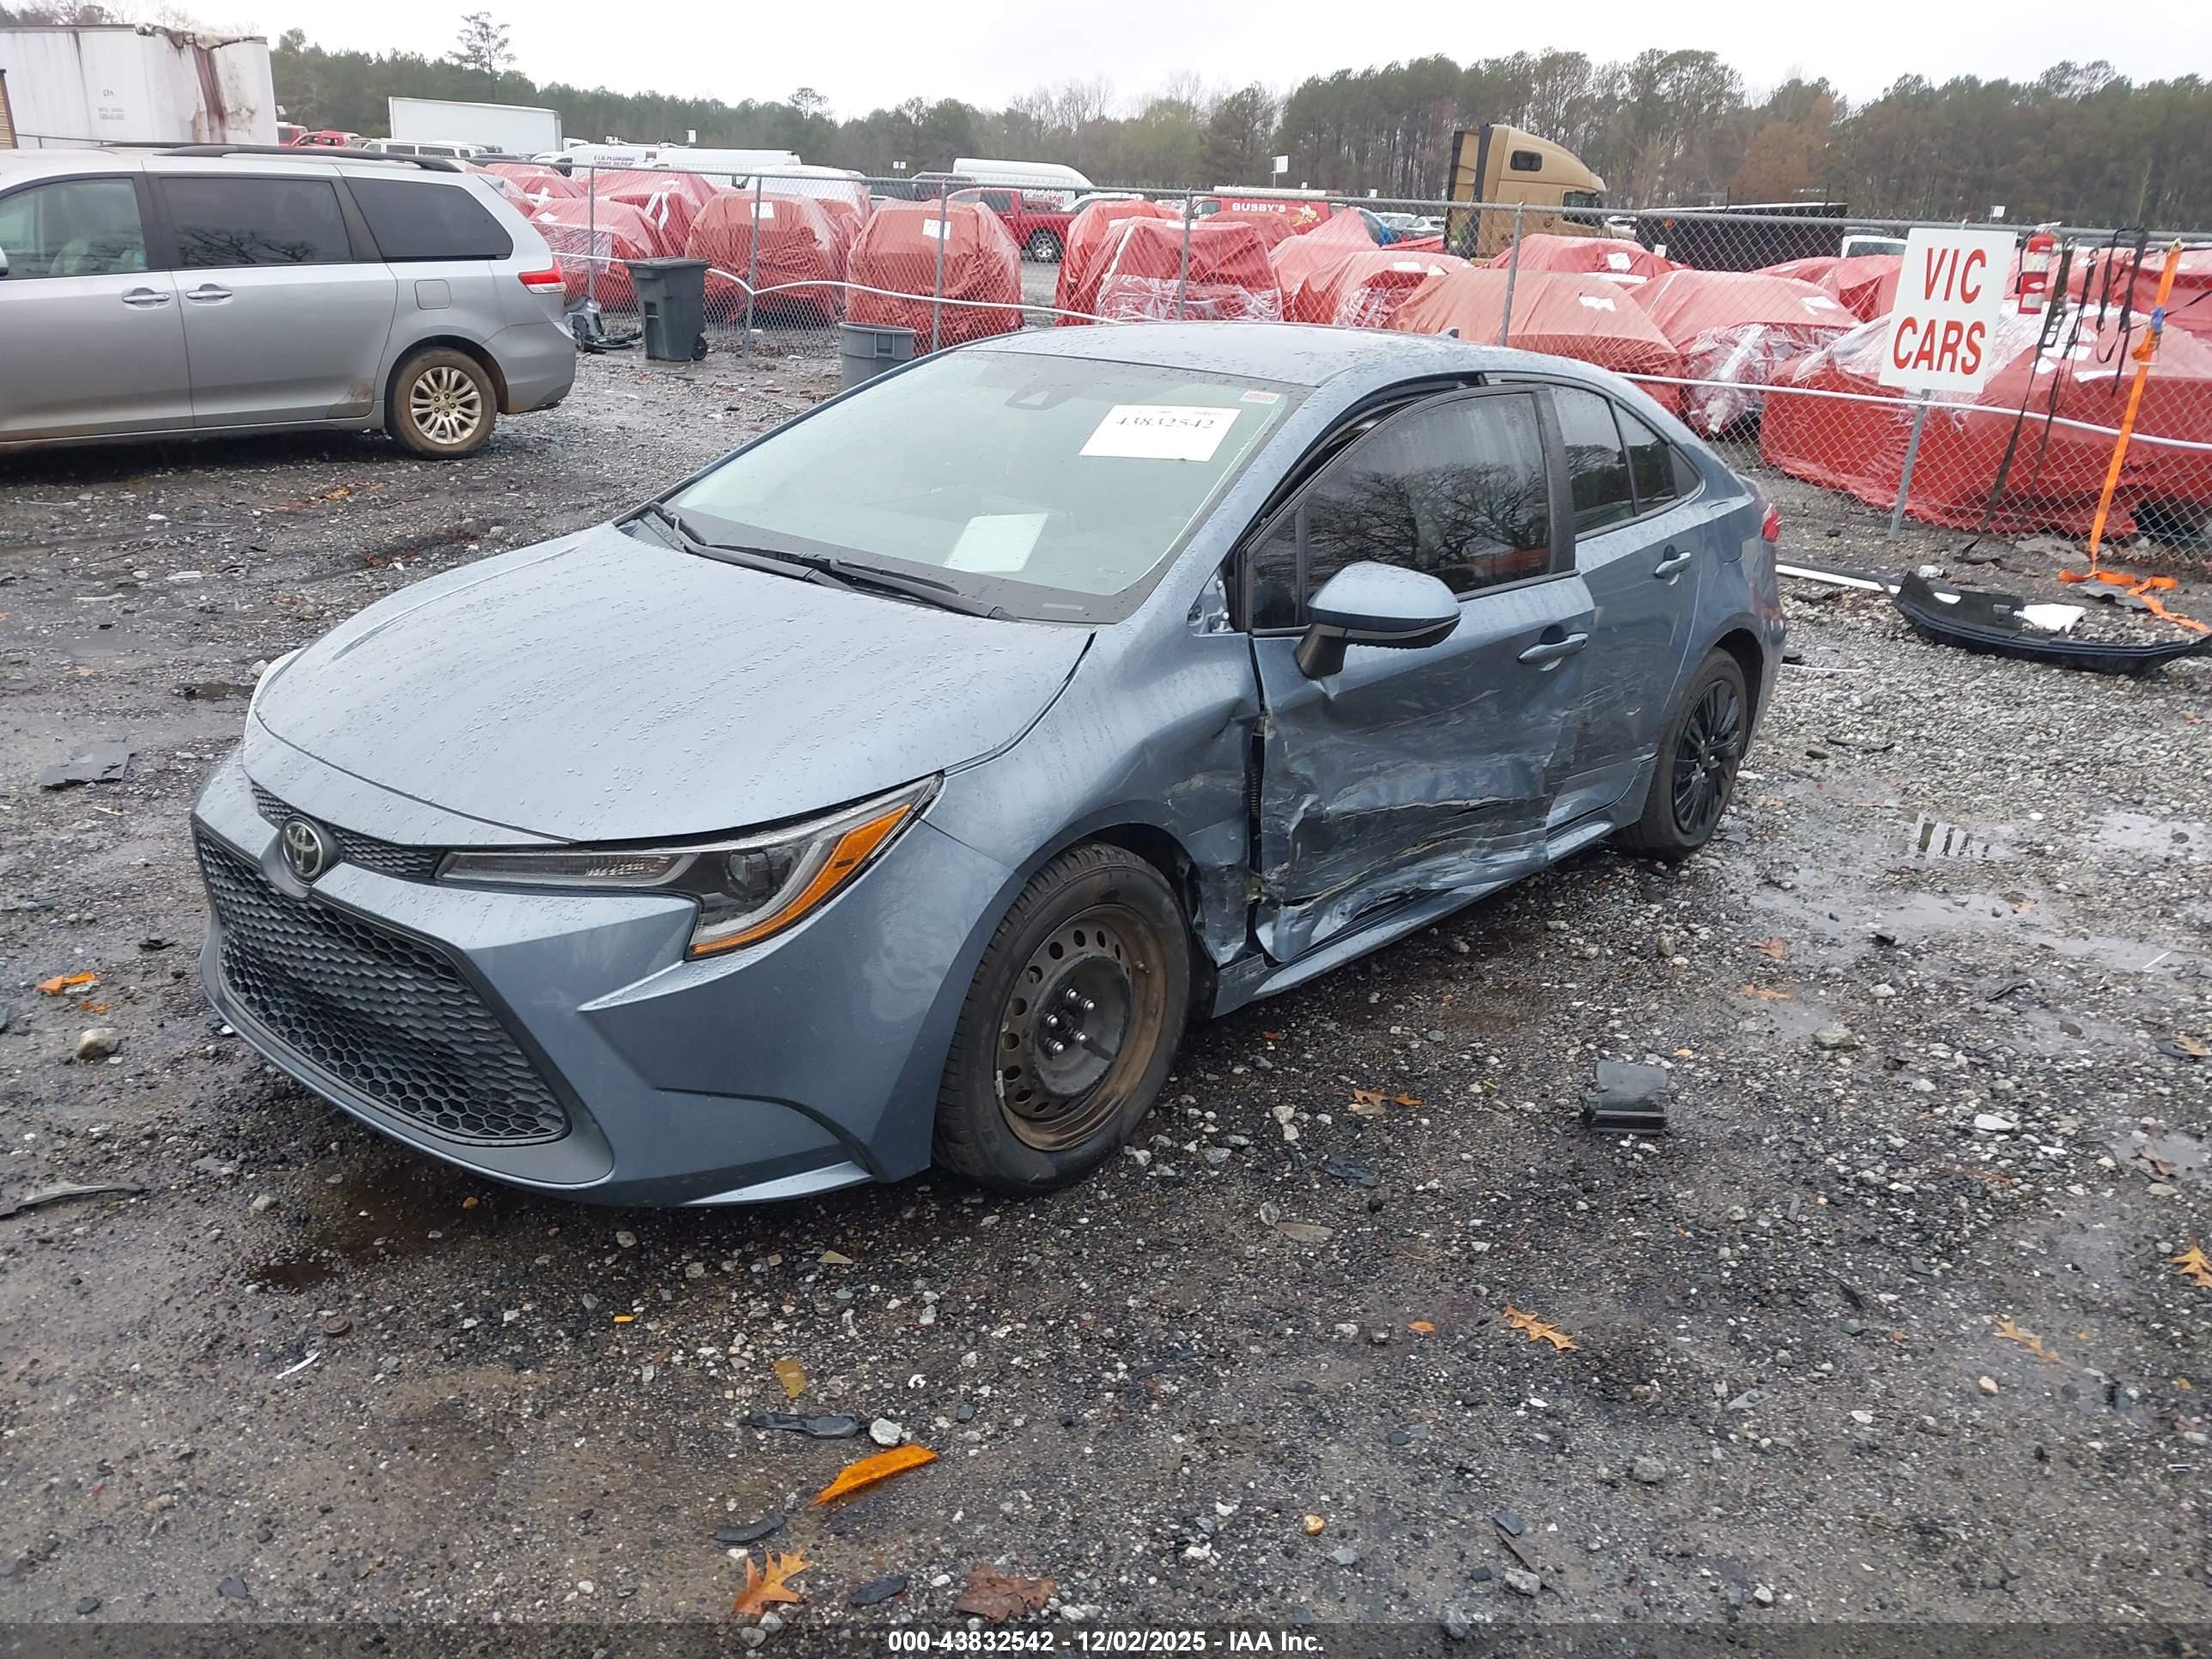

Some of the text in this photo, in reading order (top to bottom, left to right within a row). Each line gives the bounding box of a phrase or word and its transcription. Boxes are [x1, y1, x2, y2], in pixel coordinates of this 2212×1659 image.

[1231, 203, 1286, 212] BUSBY'S
[1924, 247, 1986, 303] VIC
[1893, 316, 1986, 375] CARS
[1115, 416, 1215, 428] 43832542
